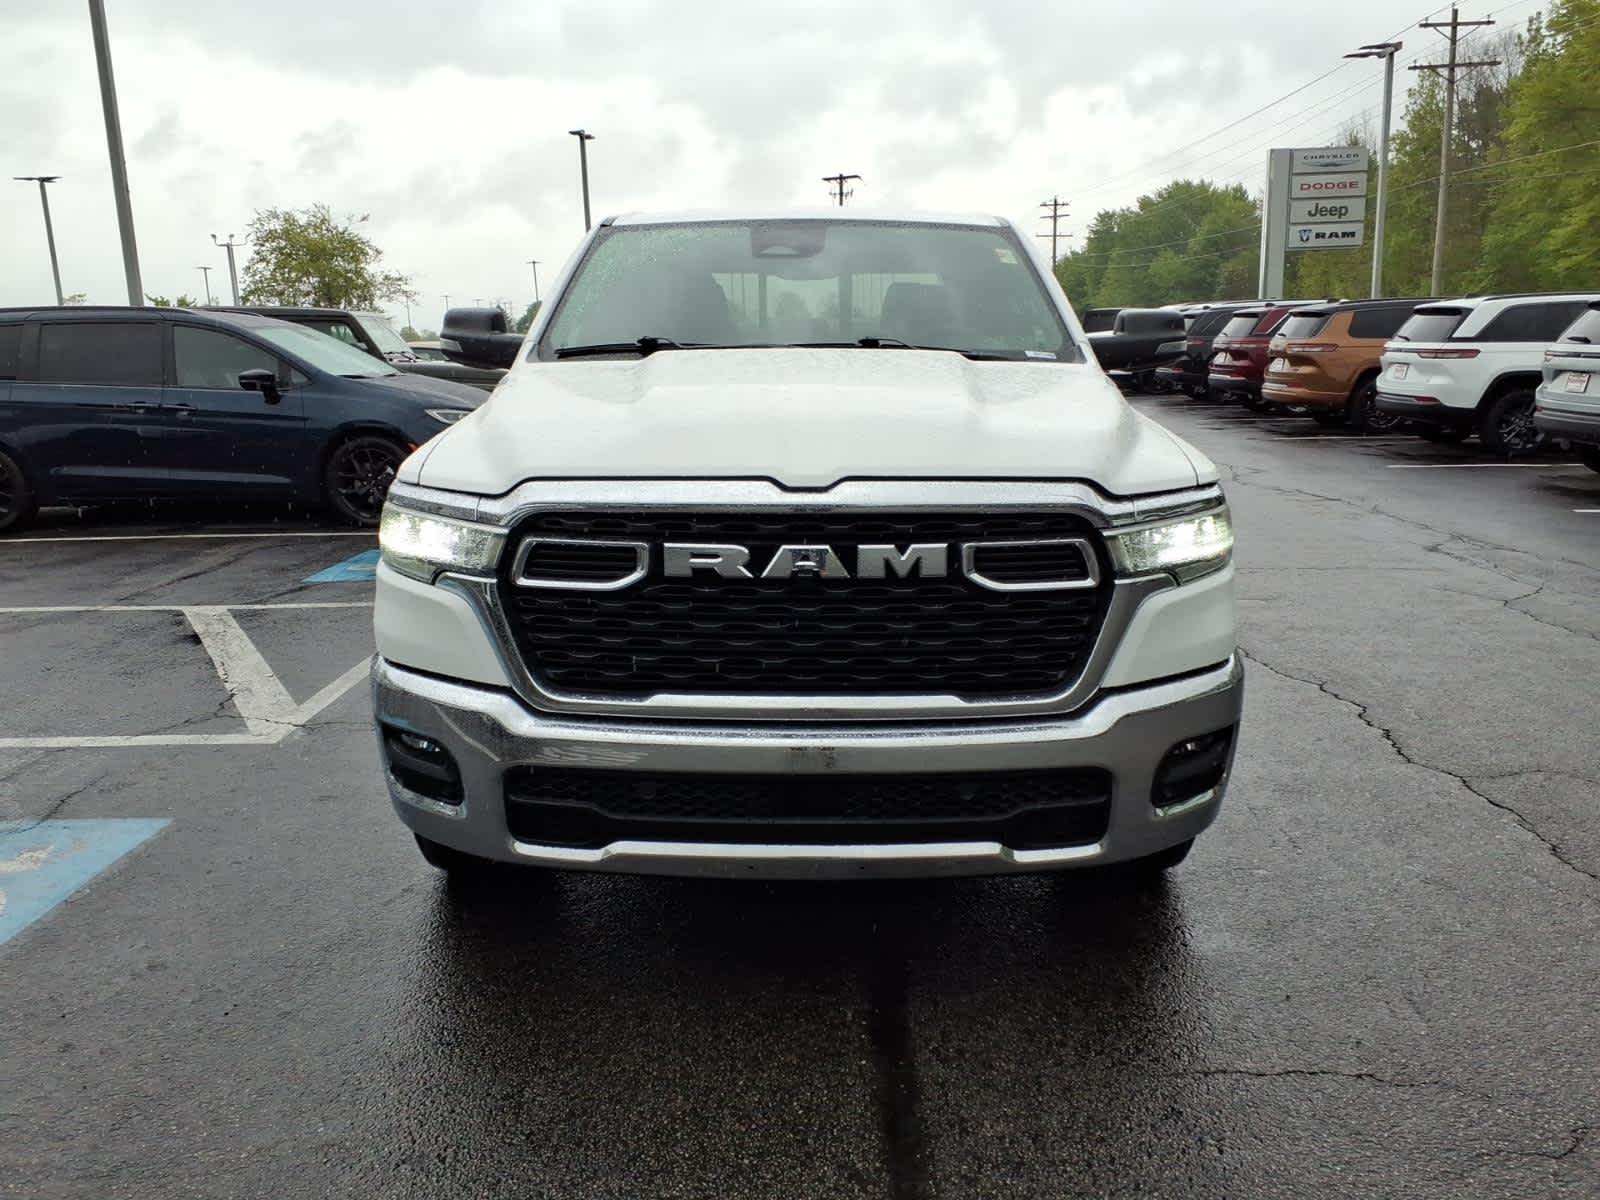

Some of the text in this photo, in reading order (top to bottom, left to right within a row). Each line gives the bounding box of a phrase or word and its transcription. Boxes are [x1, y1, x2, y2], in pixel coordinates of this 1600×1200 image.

[1300, 181, 1360, 191] DODGE
[1307, 202, 1349, 219] Jeep
[1315, 231, 1356, 240] RAM
[663, 542, 948, 578] RAM
